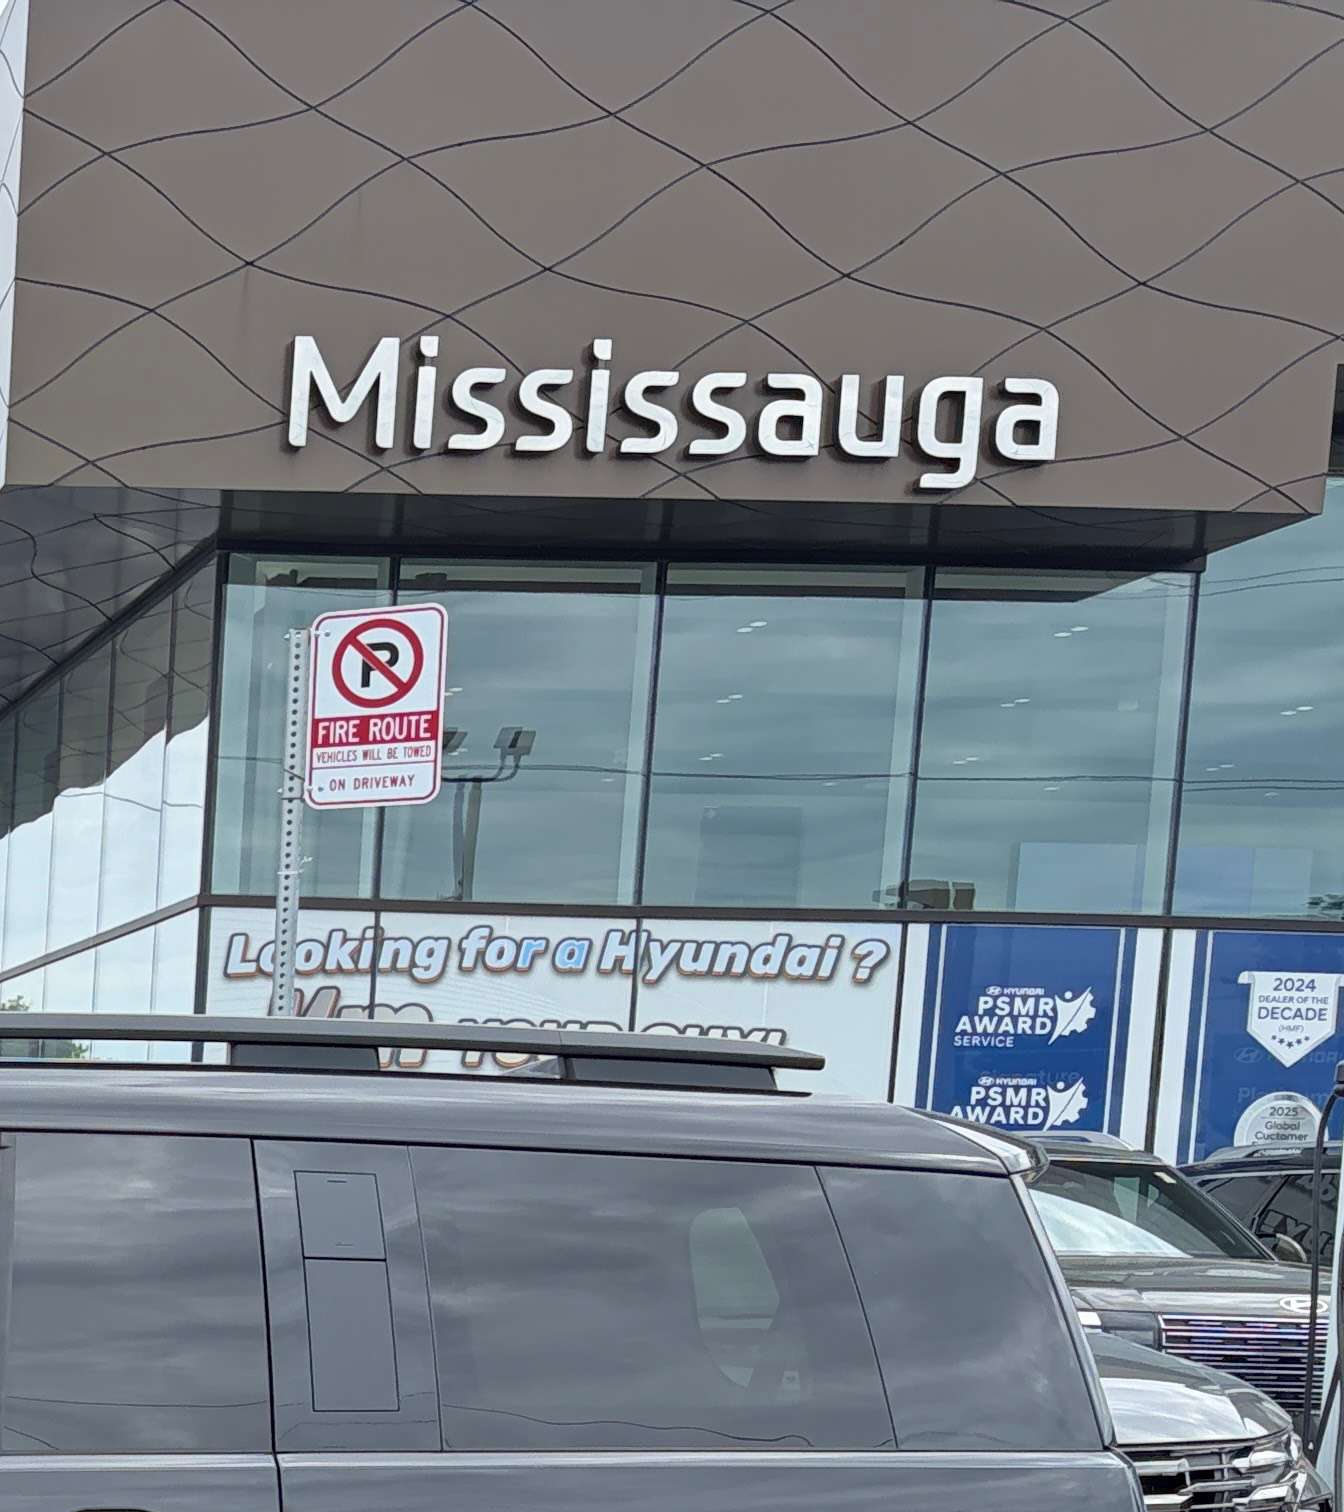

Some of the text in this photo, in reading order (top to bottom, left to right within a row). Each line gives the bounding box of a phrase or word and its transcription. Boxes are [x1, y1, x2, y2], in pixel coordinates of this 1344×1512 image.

[286, 335, 1060, 489] Mississauga
[317, 714, 432, 745] FIRE ROUTE
[316, 744, 432, 764] VEHICLES WILL BE TOWED
[329, 773, 416, 792] ON DRIVEWAY
[458, 924, 550, 972] for
[552, 936, 593, 973] a
[598, 928, 845, 985] Hyundai
[851, 938, 891, 983] ?
[1003, 986, 1045, 996] HYUNDAI
[1272, 977, 1318, 993] 2024
[977, 996, 1055, 1017] PSMR
[1258, 994, 1329, 1005] DEALER OF THE
[1257, 1006, 1329, 1022] DECADE
[954, 1015, 1052, 1035] AWARD
[953, 1035, 1015, 1048] SERVICE
[995, 1077, 1037, 1087] HYUNDAI
[969, 1086, 1047, 1107] PSMR
[949, 1105, 1045, 1126] AWARD
[1269, 1106, 1299, 1117] 2025
[1264, 1120, 1301, 1131] Global
